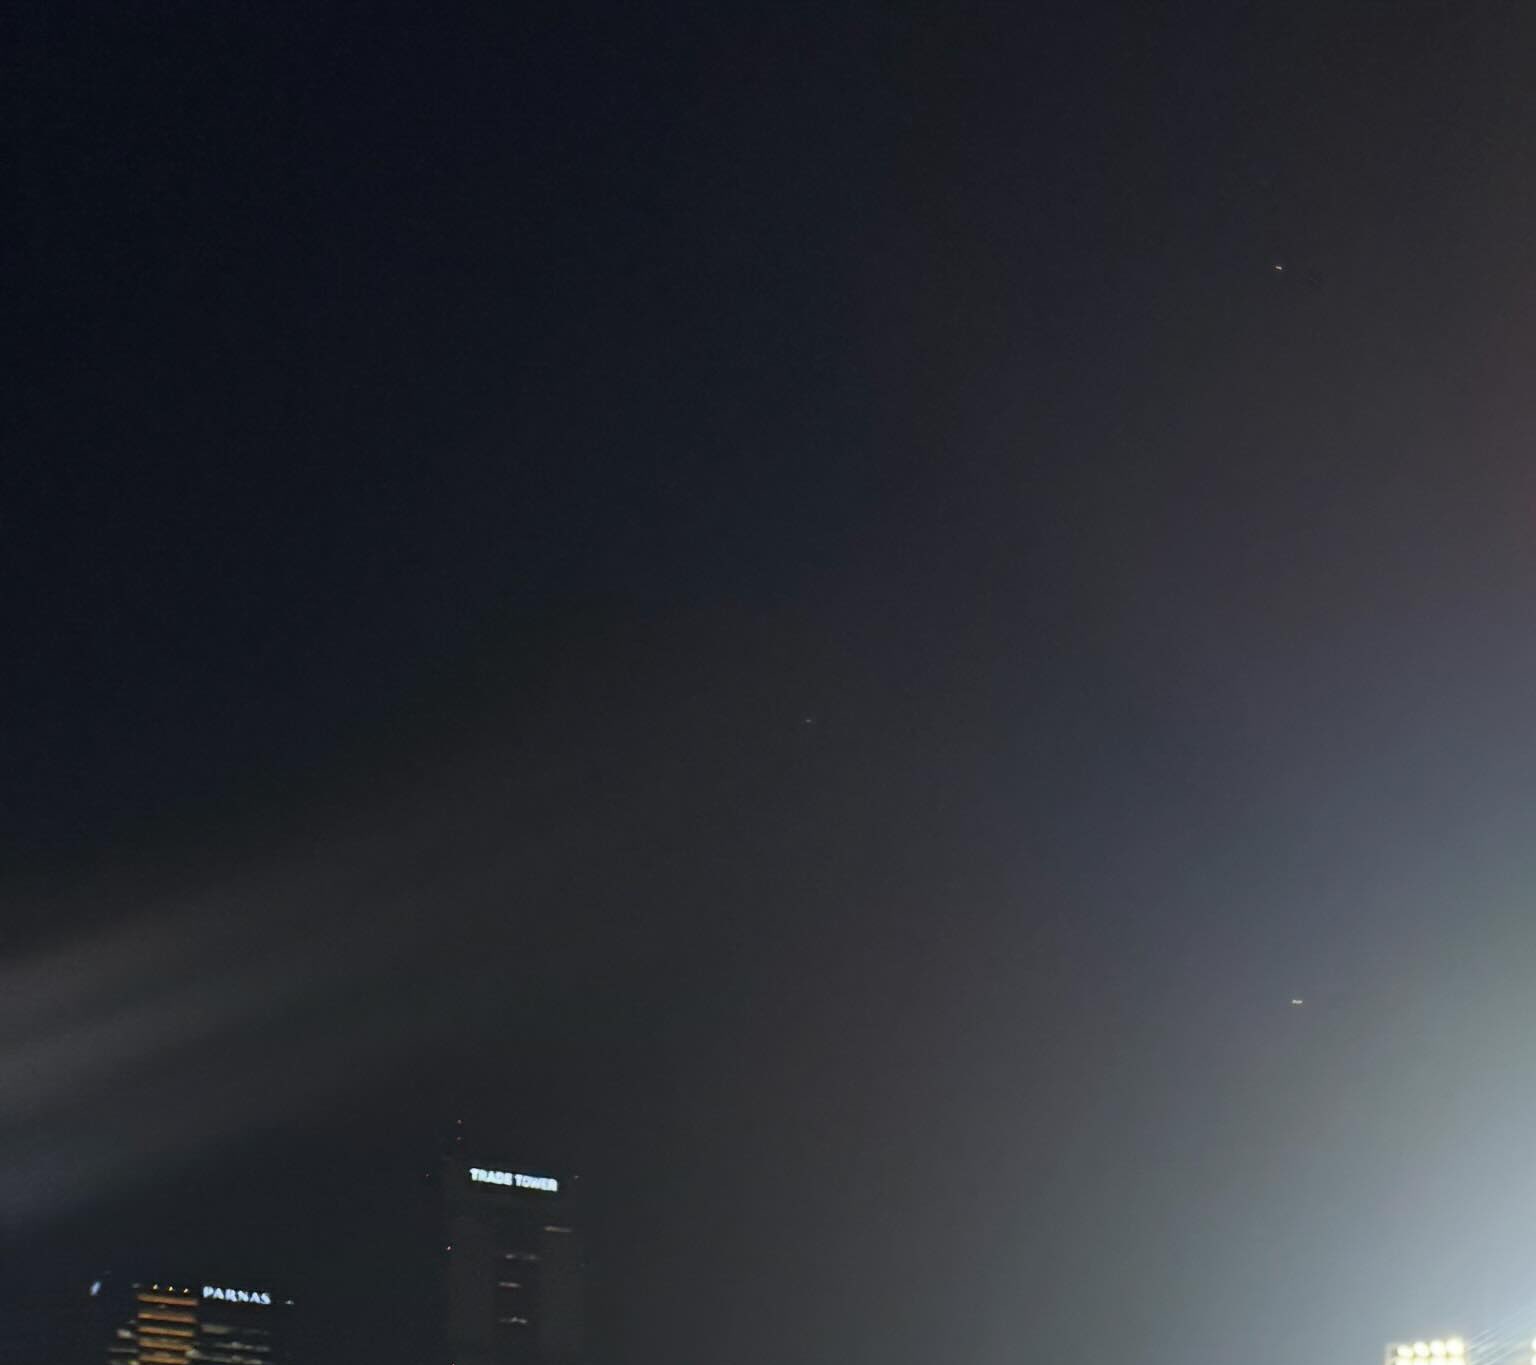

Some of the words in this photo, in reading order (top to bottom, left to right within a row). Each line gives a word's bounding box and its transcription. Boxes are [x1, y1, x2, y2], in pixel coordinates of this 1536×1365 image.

[469, 1167, 513, 1186] TRADE
[514, 1173, 558, 1192] TOWER
[202, 1286, 272, 1305] PARNAS
